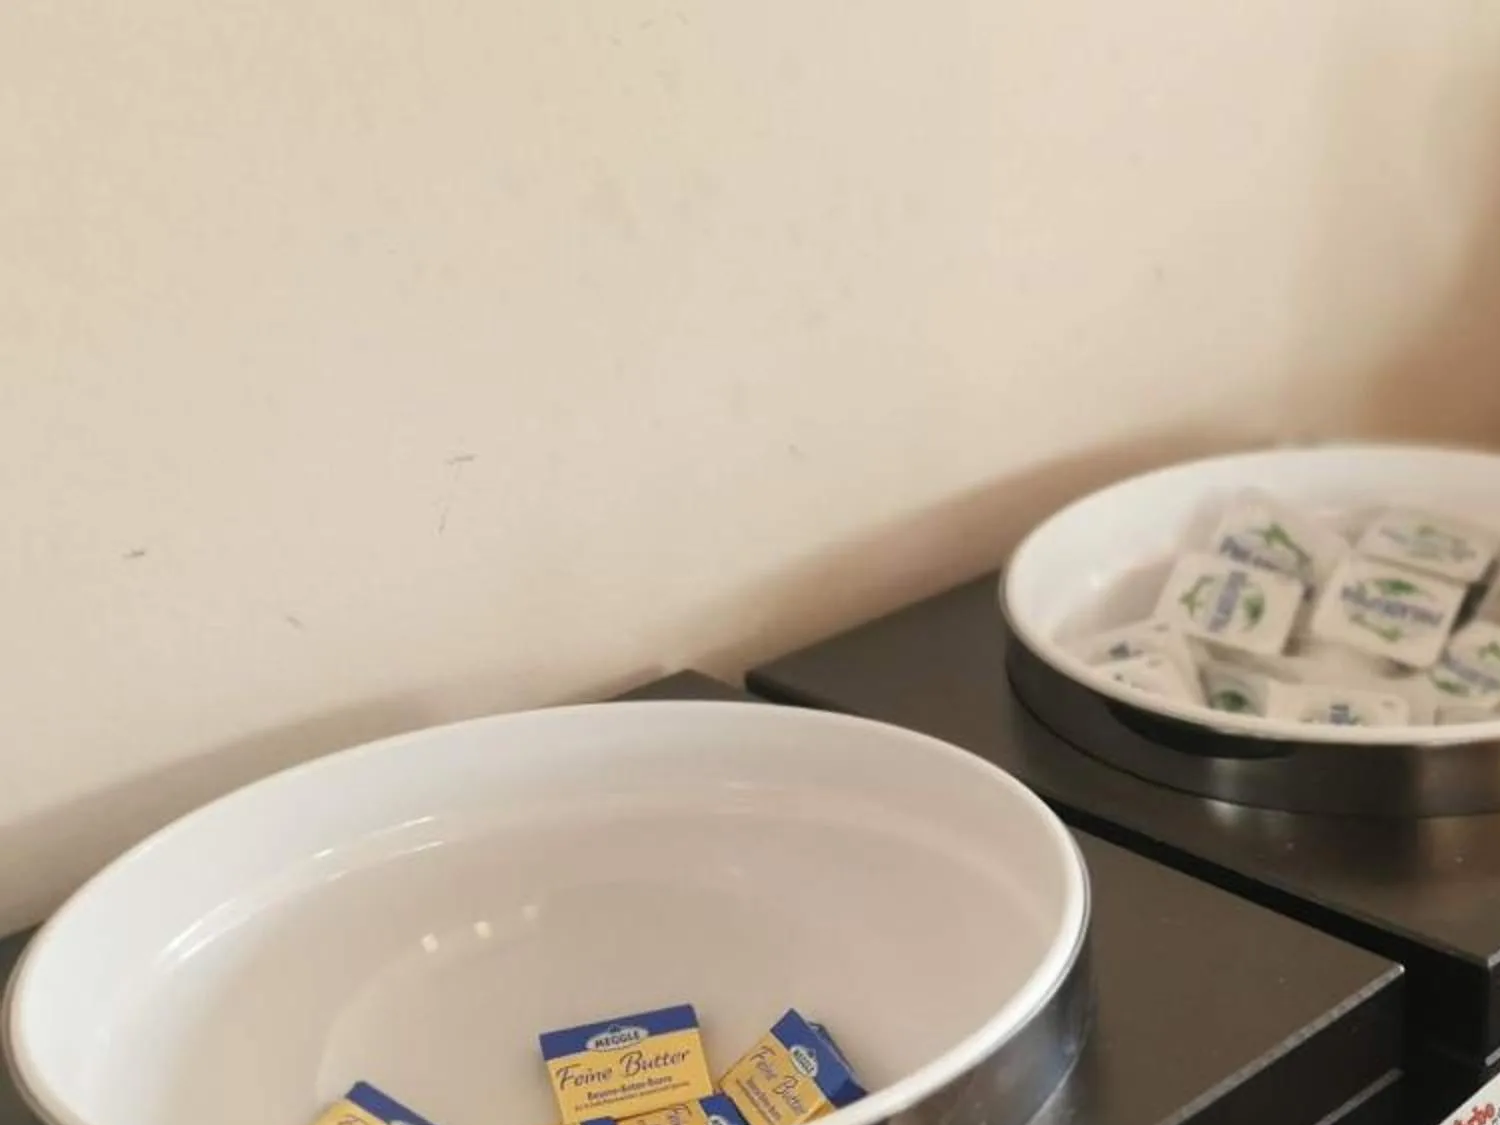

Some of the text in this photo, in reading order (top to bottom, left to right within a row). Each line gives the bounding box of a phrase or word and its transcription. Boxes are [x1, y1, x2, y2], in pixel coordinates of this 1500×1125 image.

[594, 1029, 642, 1048] MEGGLE
[556, 1063, 613, 1091] Feine
[619, 1049, 691, 1078] Butter
